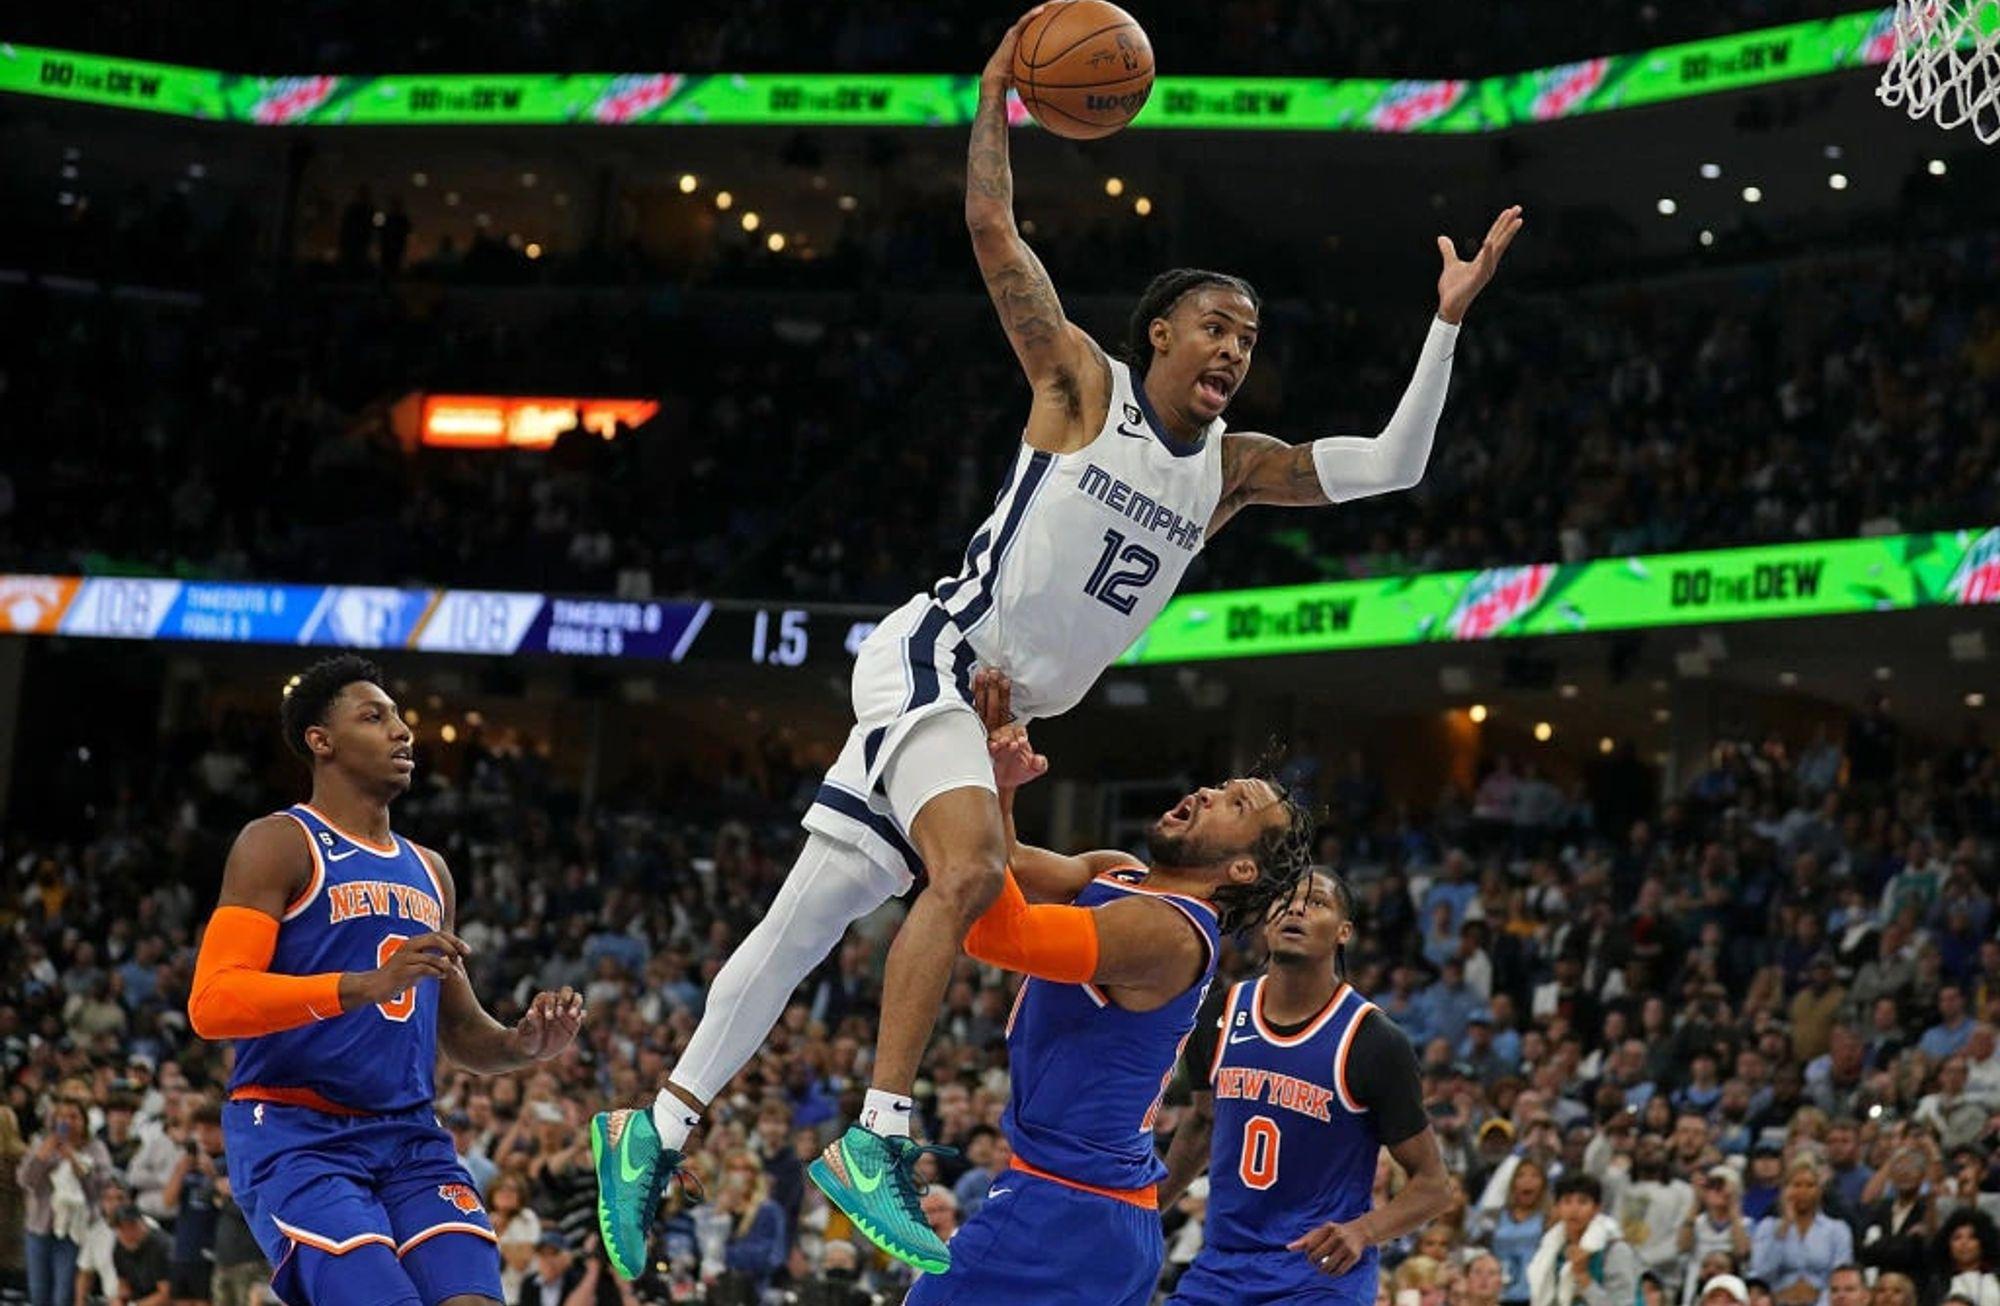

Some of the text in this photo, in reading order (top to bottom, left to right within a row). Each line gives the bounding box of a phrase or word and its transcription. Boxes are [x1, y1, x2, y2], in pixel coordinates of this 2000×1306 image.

[1083, 527, 1161, 616] 12
[1672, 567, 1711, 608] DO
[1753, 558, 1825, 601] DEW
[752, 609, 809, 666] 1.5
[1227, 604, 1260, 641] DO
[1297, 597, 1358, 634] DEW
[318, 831, 334, 847] 6
[328, 881, 390, 925] NEW
[1235, 1011, 1248, 1027] 6
[1216, 1067, 1269, 1100] NEW
[1267, 1072, 1334, 1122] YORK
[1239, 1115, 1281, 1191] 0
